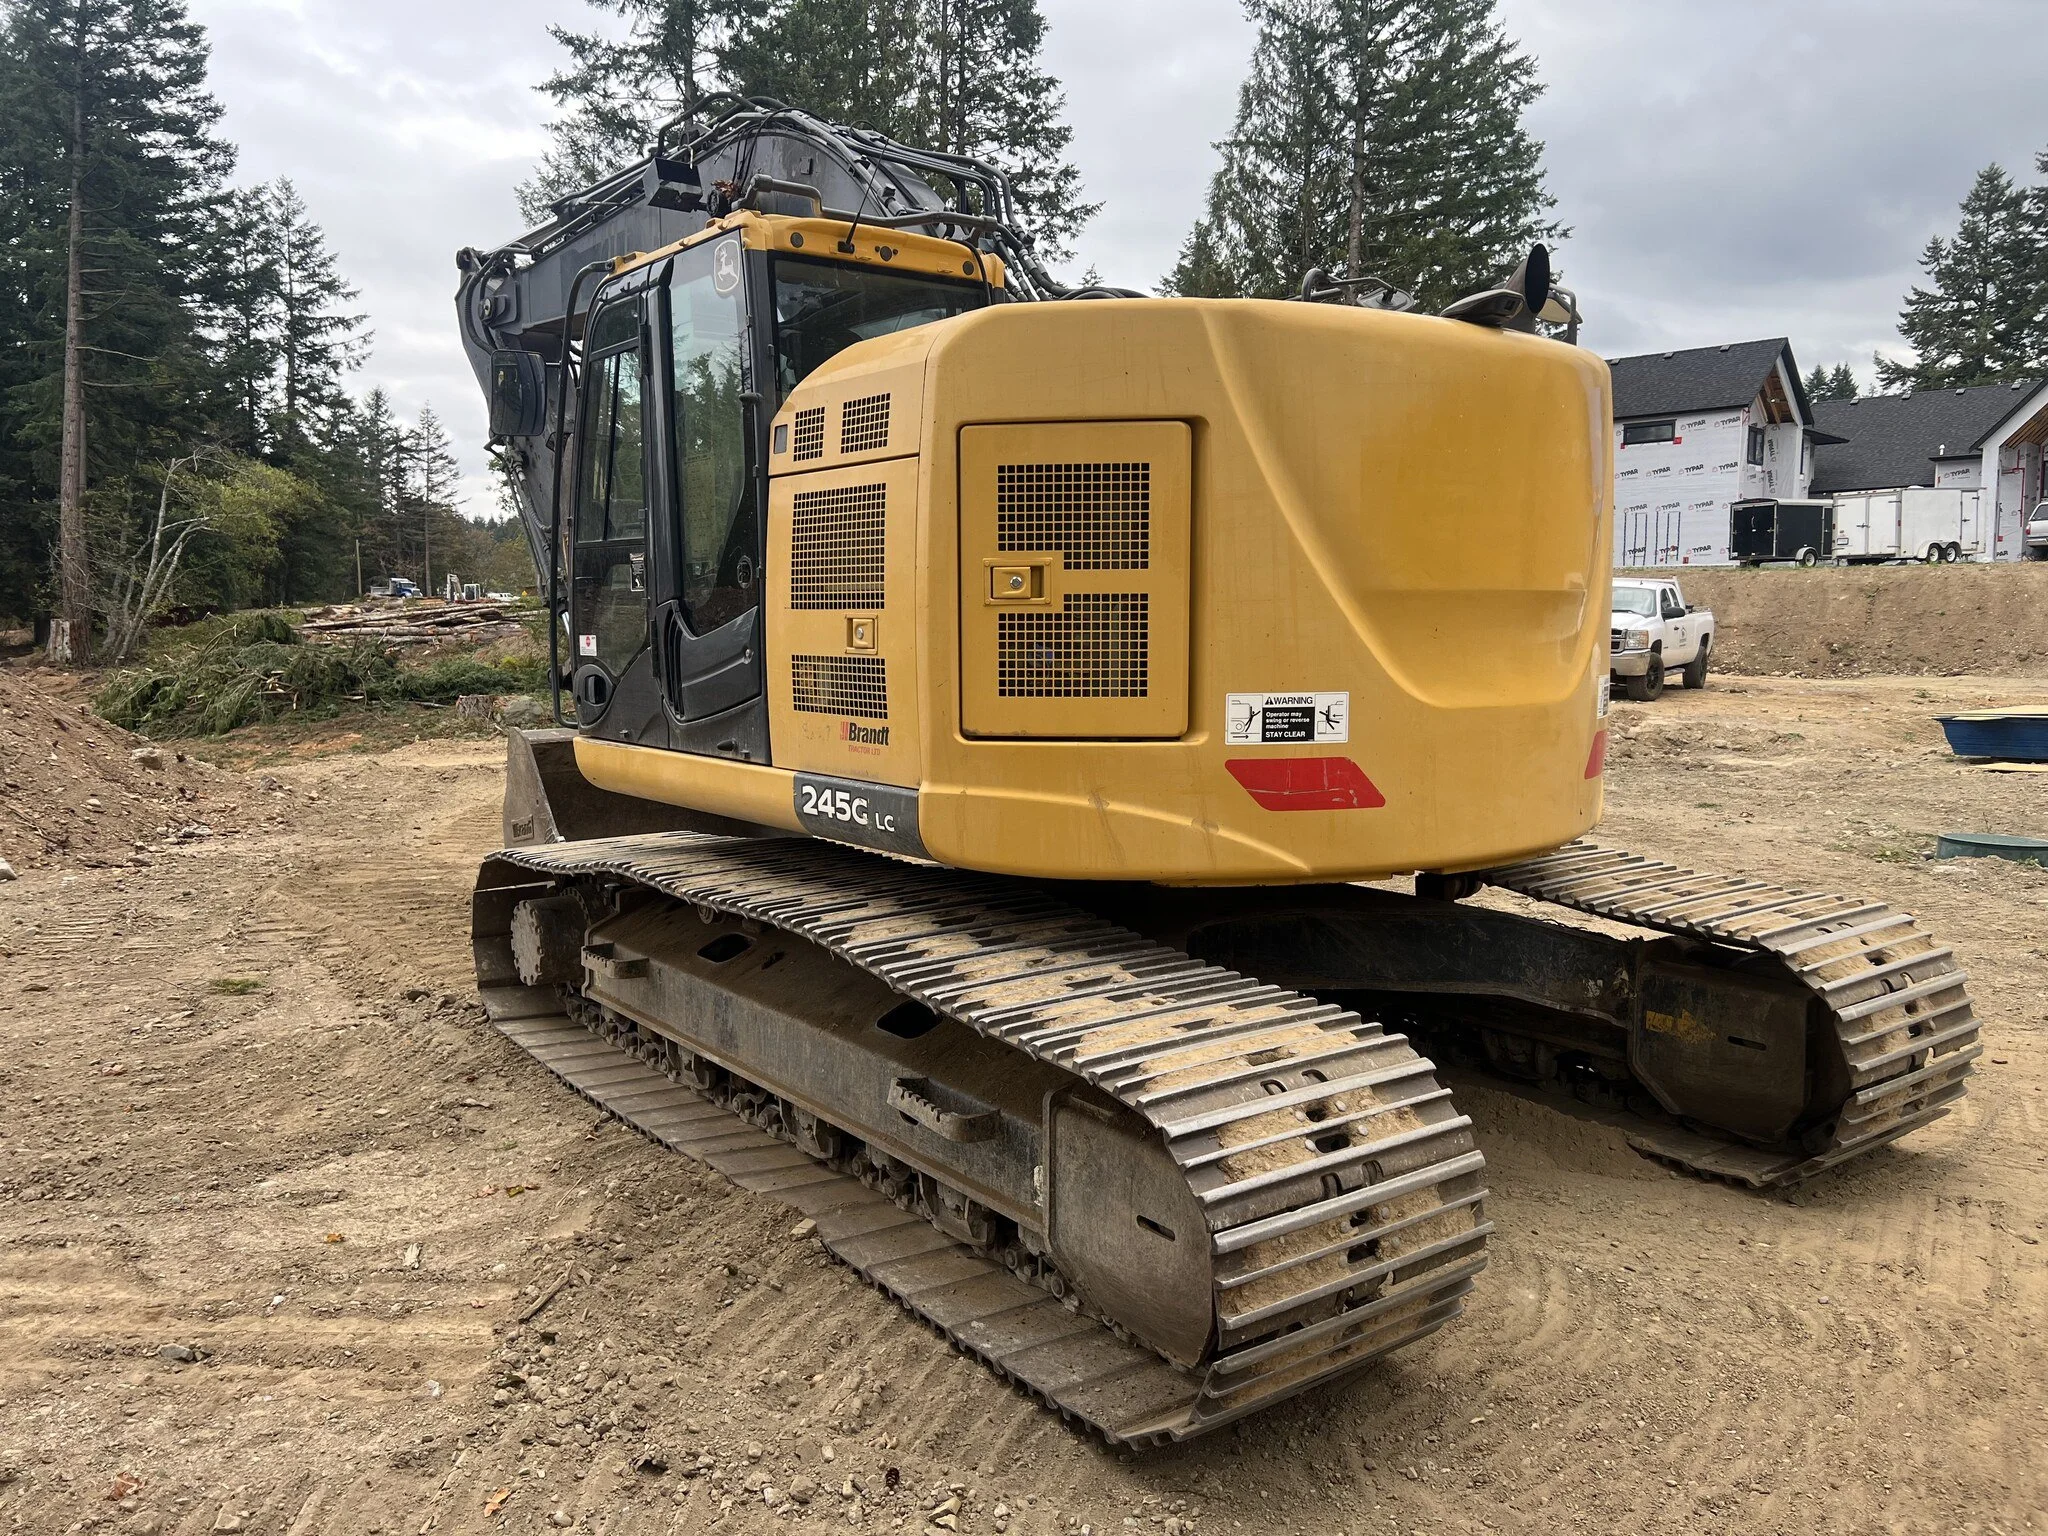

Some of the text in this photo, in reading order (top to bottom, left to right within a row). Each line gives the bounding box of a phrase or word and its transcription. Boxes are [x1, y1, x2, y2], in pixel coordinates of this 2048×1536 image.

[1687, 420, 1706, 428] TYPAR
[1720, 416, 1740, 425] TYPAR
[1652, 467, 1670, 475] TYPAR
[1685, 464, 1704, 473] TYPAR
[1719, 462, 1738, 471] TYPAR
[1620, 469, 1638, 477] TYPAR
[1950, 469, 1970, 477] TYPAR
[1629, 504, 1648, 512] TYPAR
[1661, 502, 1680, 511] TYPAR
[1694, 501, 1714, 509] TYPAR
[1628, 547, 1646, 555] TYPAR
[1692, 545, 1711, 554] TYPAR
[1274, 696, 1313, 705] WARNING
[849, 722, 889, 746] Brandt
[848, 745, 870, 754] TRACTOR
[802, 785, 895, 832] 245G LC
